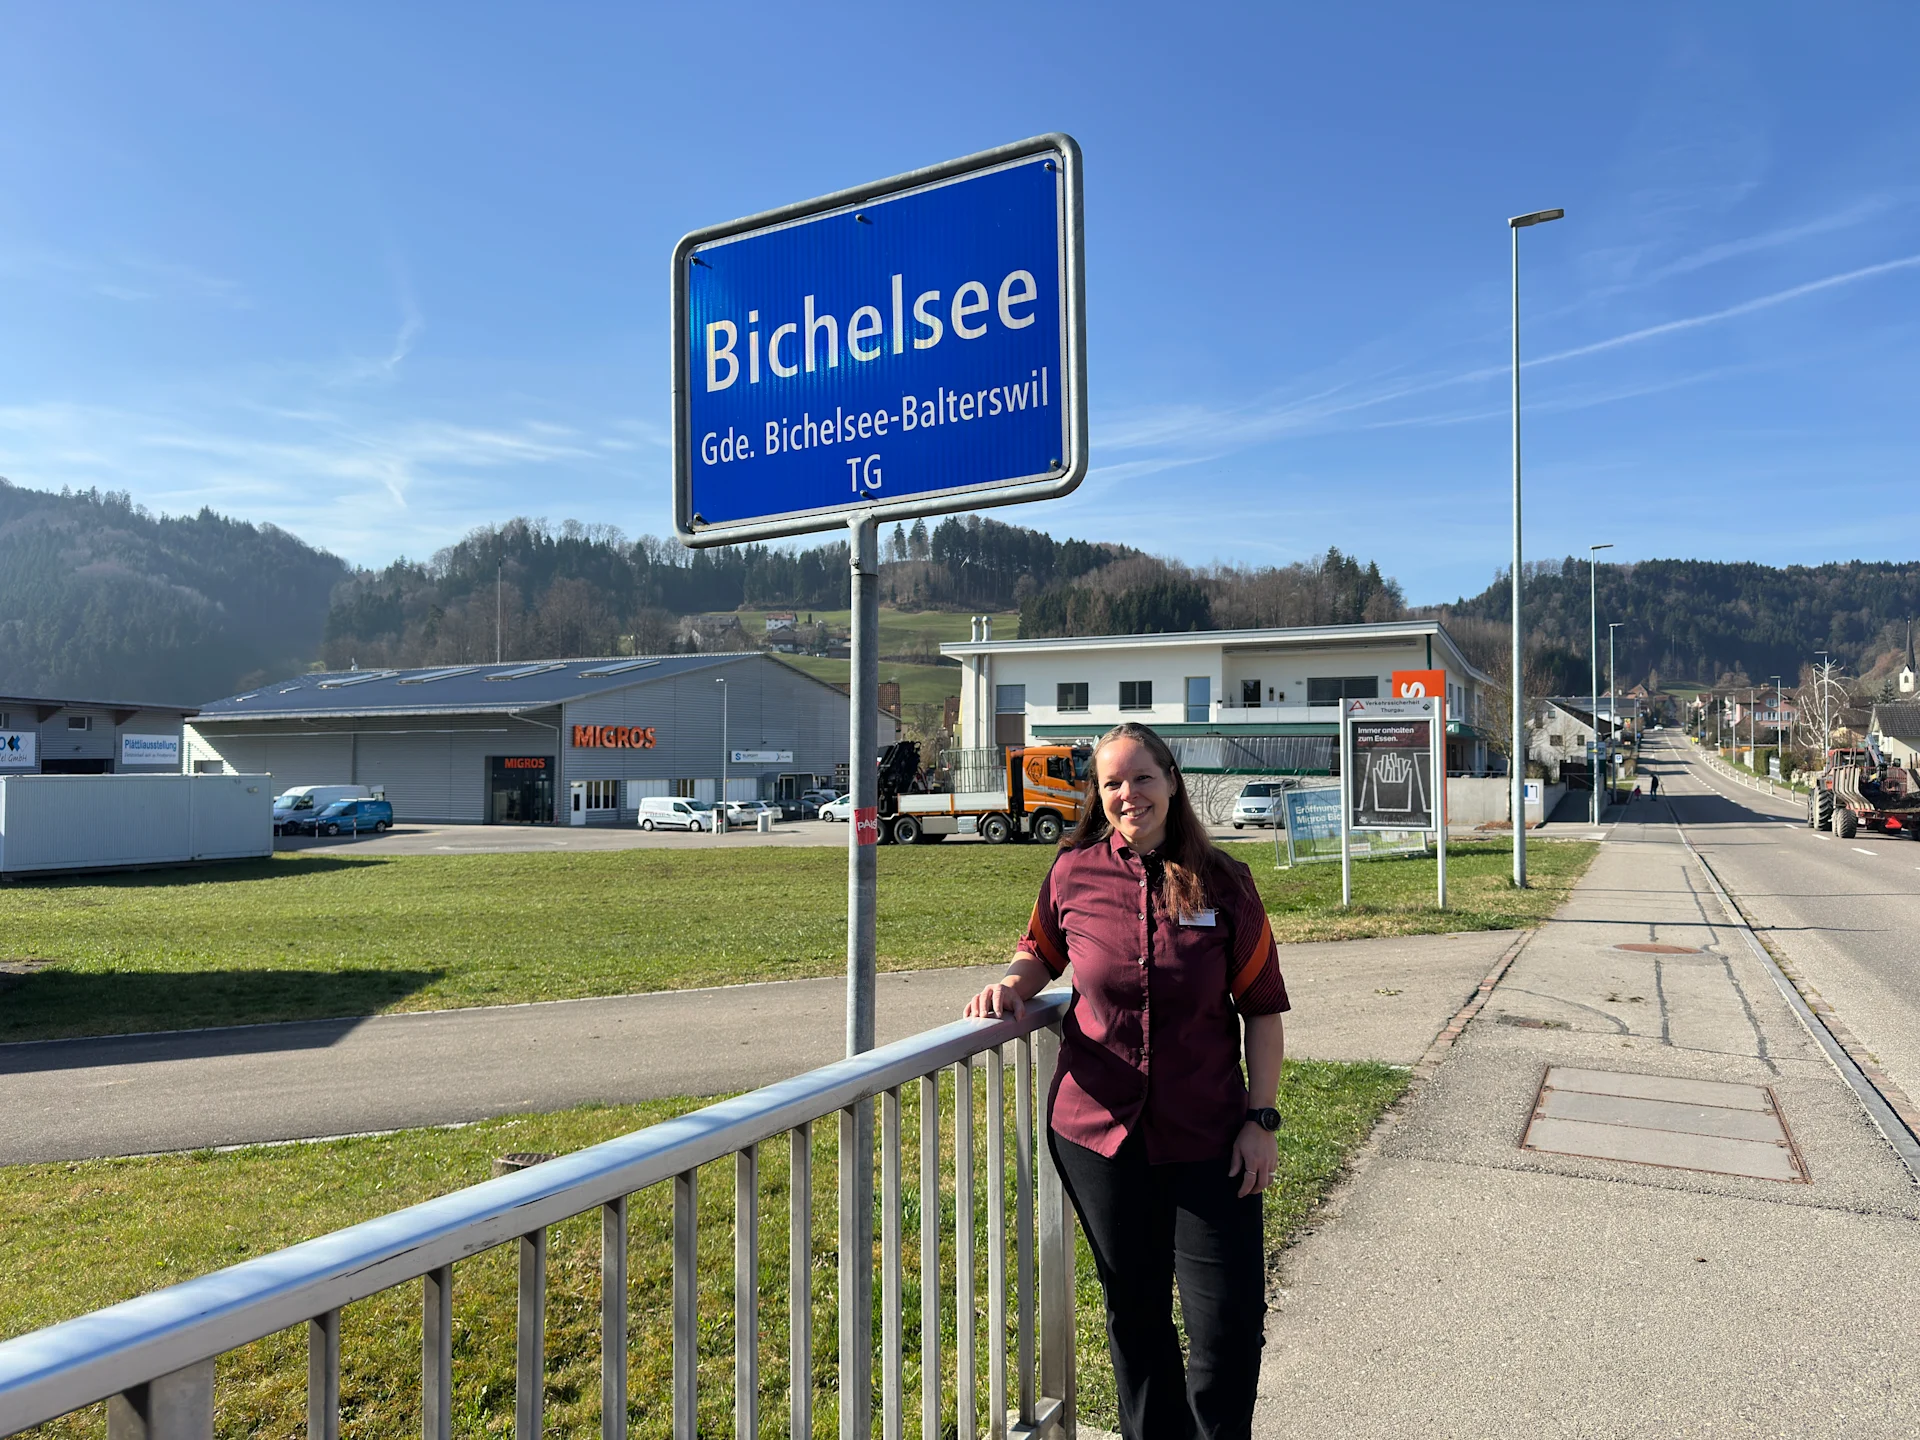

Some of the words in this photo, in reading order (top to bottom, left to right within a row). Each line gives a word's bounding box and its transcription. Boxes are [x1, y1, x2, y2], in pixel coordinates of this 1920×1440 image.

[705, 268, 1038, 393] Bichelsee
[701, 426, 755, 466] Gde.
[765, 366, 1049, 455] Bichelsee-Balterswil
[846, 453, 882, 492] TG
[573, 724, 657, 749] MIGROS
[504, 757, 546, 769] MIGROS
